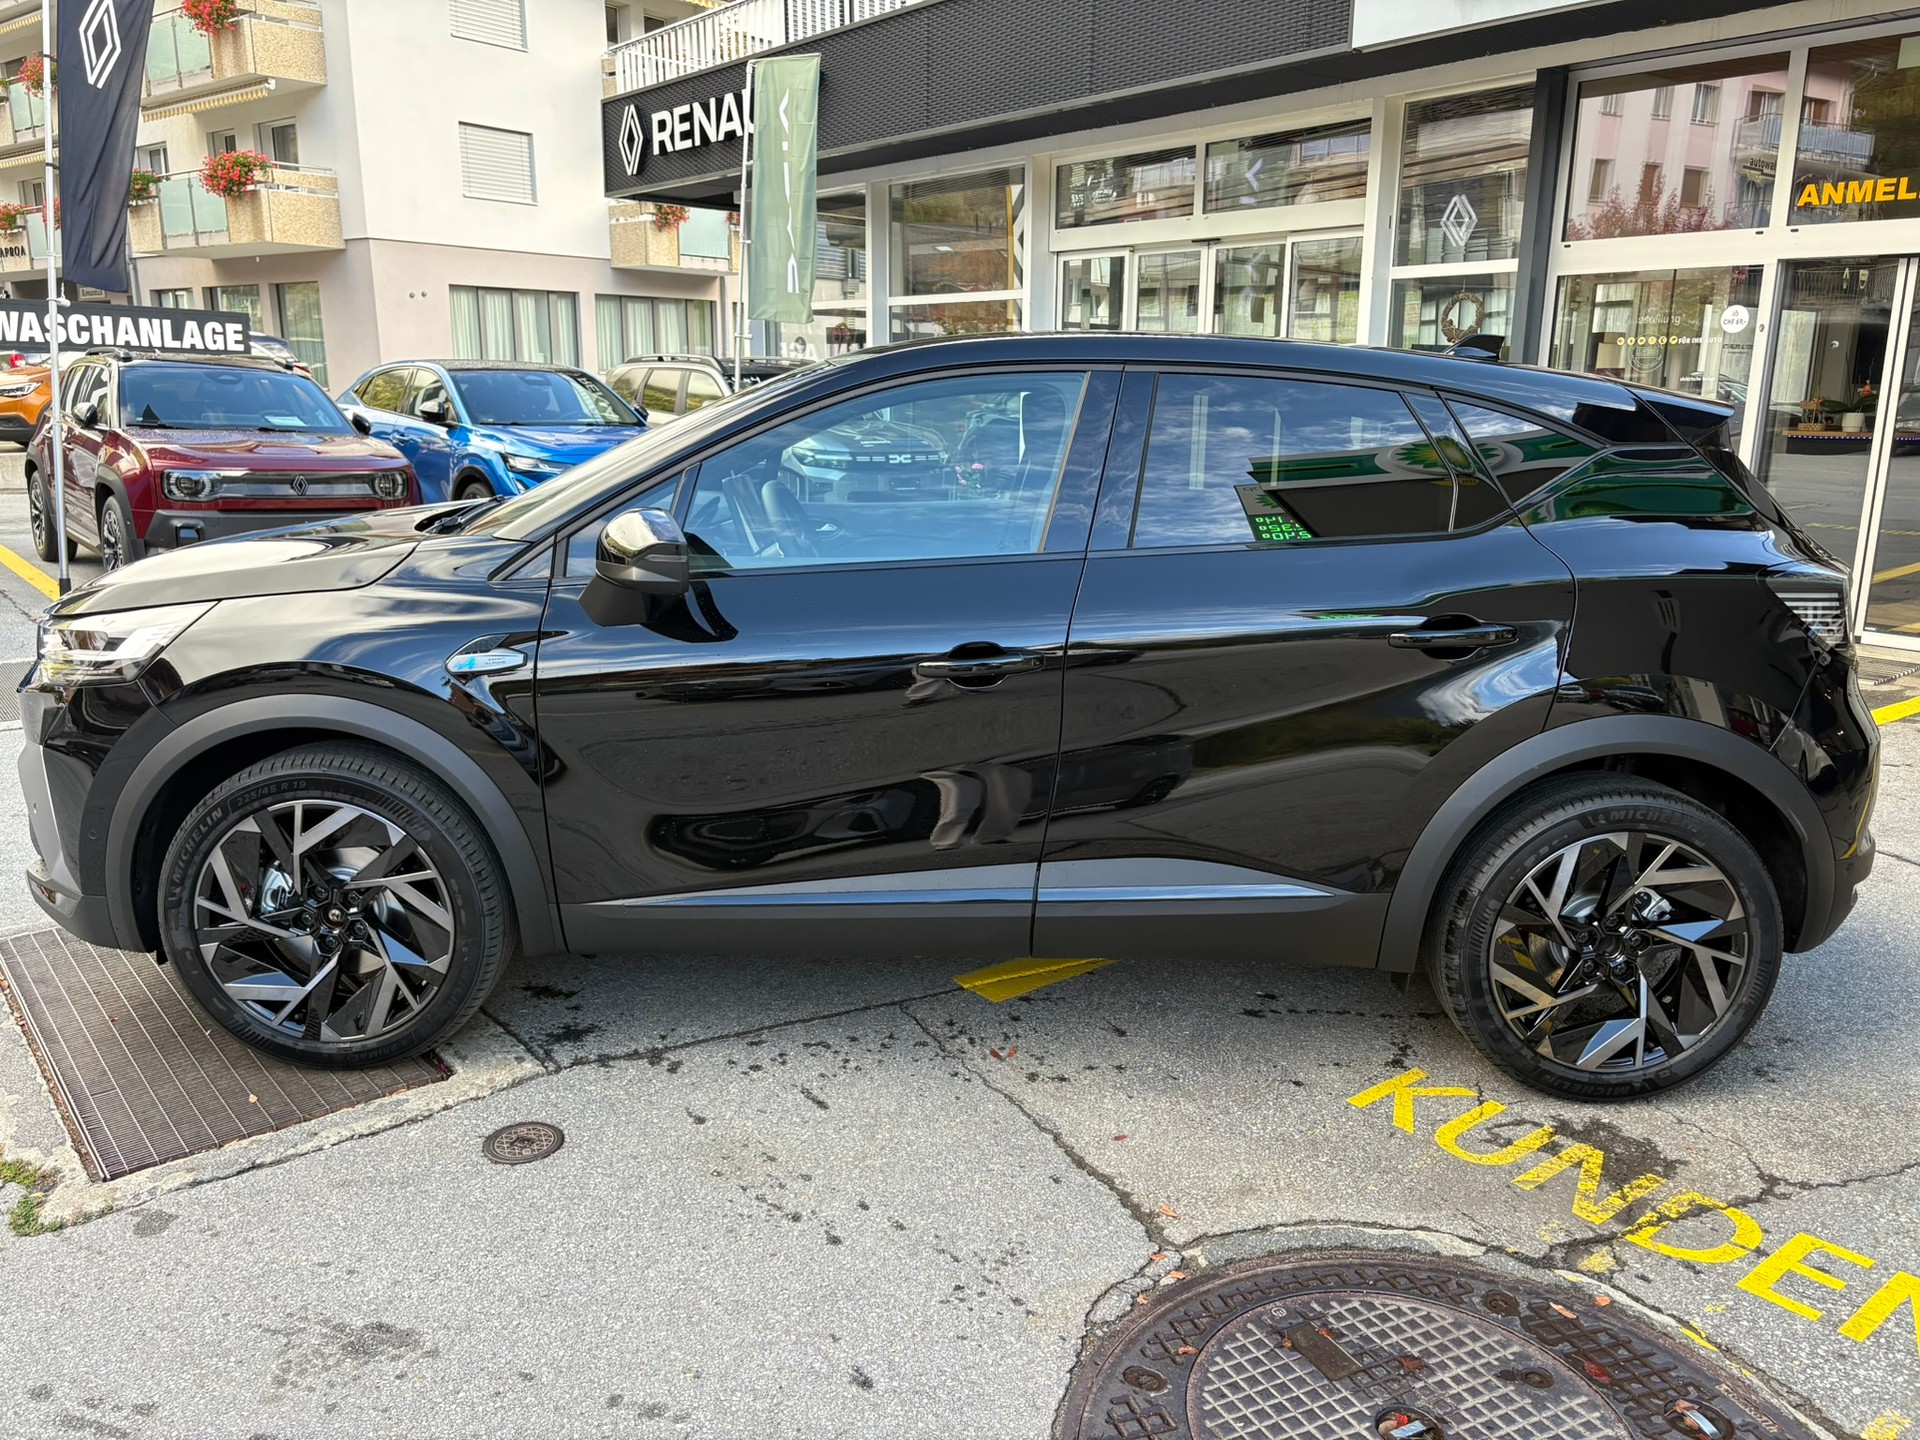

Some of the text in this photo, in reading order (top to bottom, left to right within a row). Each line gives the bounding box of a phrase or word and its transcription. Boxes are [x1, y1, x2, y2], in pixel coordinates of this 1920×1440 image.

[1797, 176, 1920, 207] ANMEL
[281, 783, 289, 791] R
[293, 780, 306, 789] 19
[171, 806, 224, 885] MICHELIN
